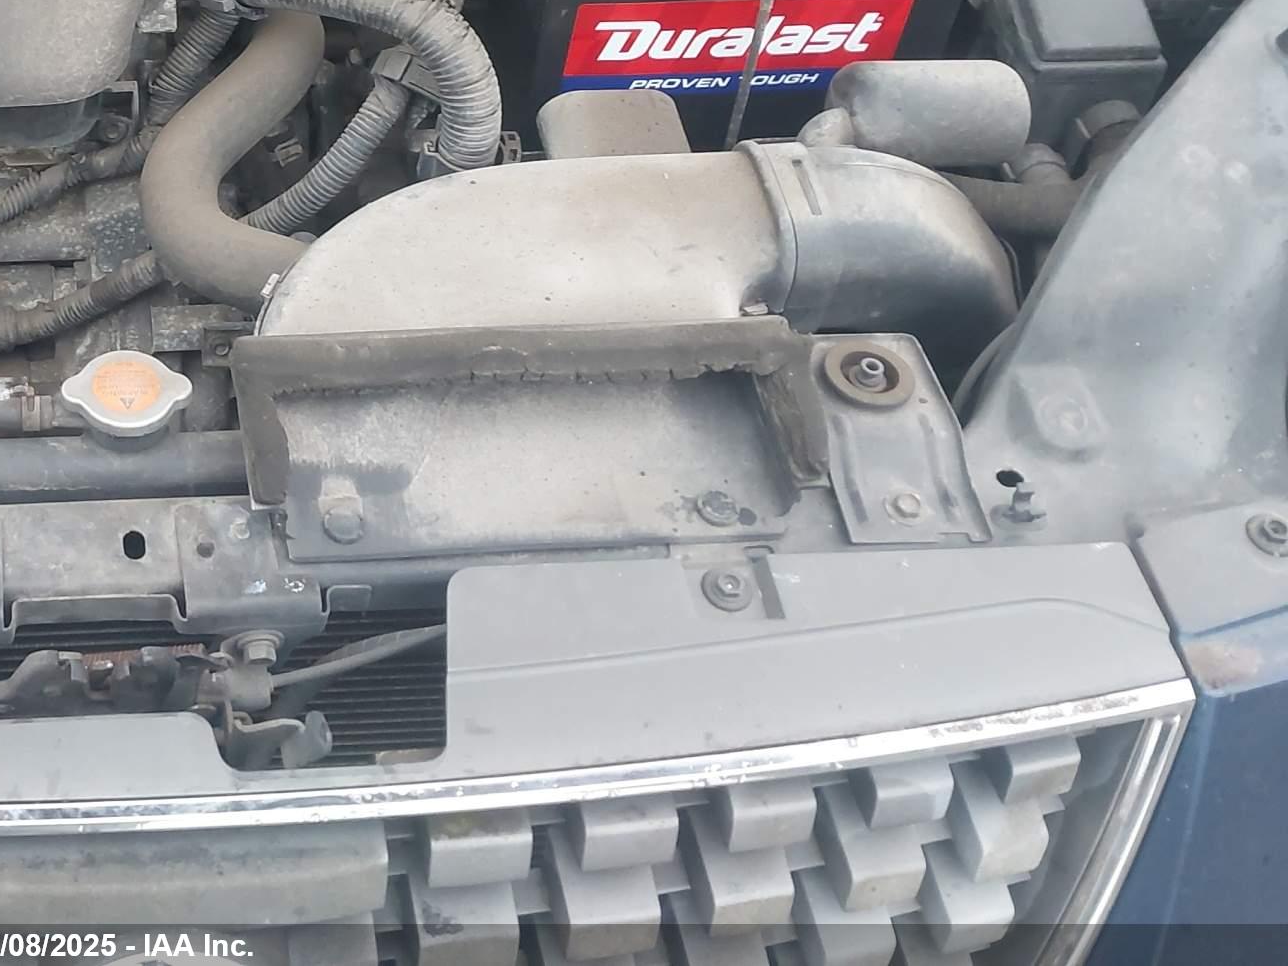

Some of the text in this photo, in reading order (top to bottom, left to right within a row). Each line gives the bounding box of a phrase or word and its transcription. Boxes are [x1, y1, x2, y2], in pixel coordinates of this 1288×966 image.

[594, 12, 883, 61] Duralast
[629, 73, 820, 90] PROVEN OUGH
